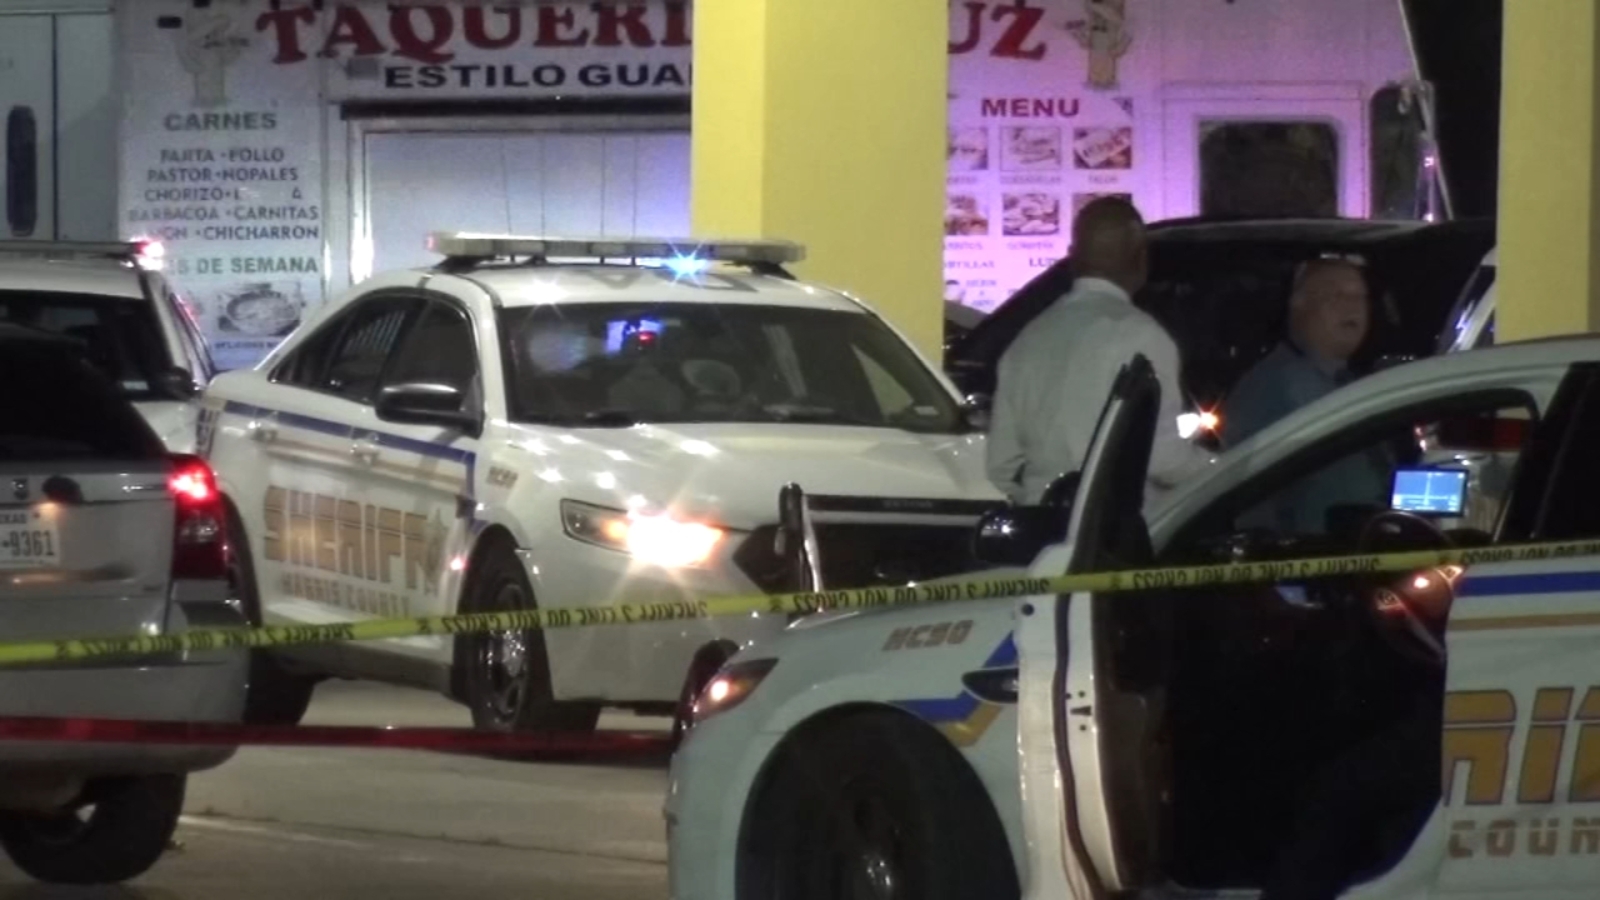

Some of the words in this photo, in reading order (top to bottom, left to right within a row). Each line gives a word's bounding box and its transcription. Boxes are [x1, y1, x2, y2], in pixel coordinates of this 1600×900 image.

[385, 64, 567, 88] ESTILO
[578, 63, 692, 87] GUA
[981, 97, 1080, 118] MENU
[164, 112, 277, 131] CARNES
[161, 150, 214, 163] FAJITA
[147, 168, 212, 183] PASTOR
[222, 167, 299, 181] NOPALES
[144, 187, 223, 201] CHORIZO
[129, 207, 219, 222] BARBACOA
[234, 206, 319, 221] CARNITAS
[203, 225, 319, 241] CHICHARRON
[196, 257, 224, 275] DE
[231, 256, 319, 275] SEMANA
[263, 484, 429, 591] SHERIFF
[857, 588, 888, 607] NOT
[895, 585, 917, 604] DO
[923, 583, 960, 602] LINE
[508, 609, 541, 628] NOT
[547, 609, 571, 626] DO
